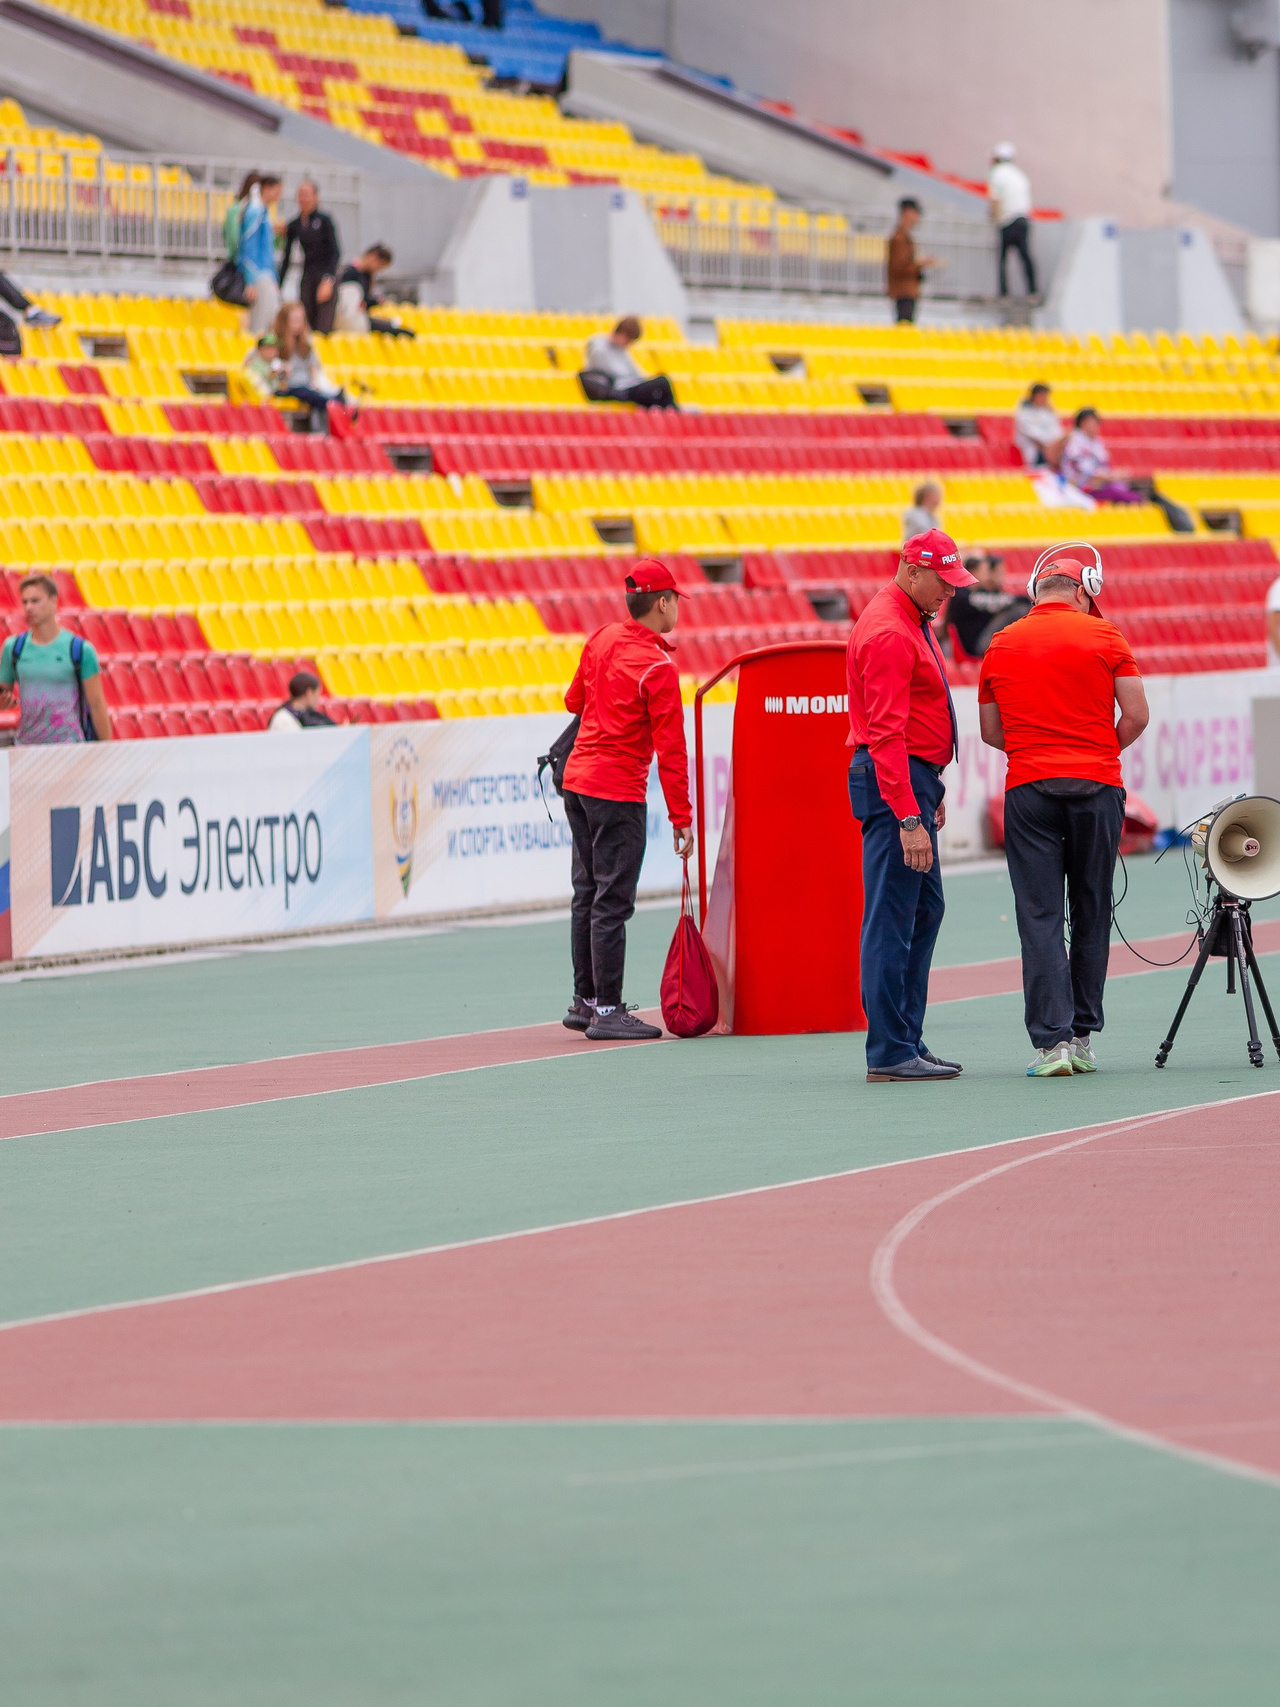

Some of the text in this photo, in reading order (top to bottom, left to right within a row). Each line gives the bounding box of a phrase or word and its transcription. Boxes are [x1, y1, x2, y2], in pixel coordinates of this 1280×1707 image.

[432, 774, 528, 808] МИНИСТЕРСТВО
[87, 797, 322, 910] АБС Электро
[448, 820, 573, 858] И СПОРТА ЧУВАШСКО
